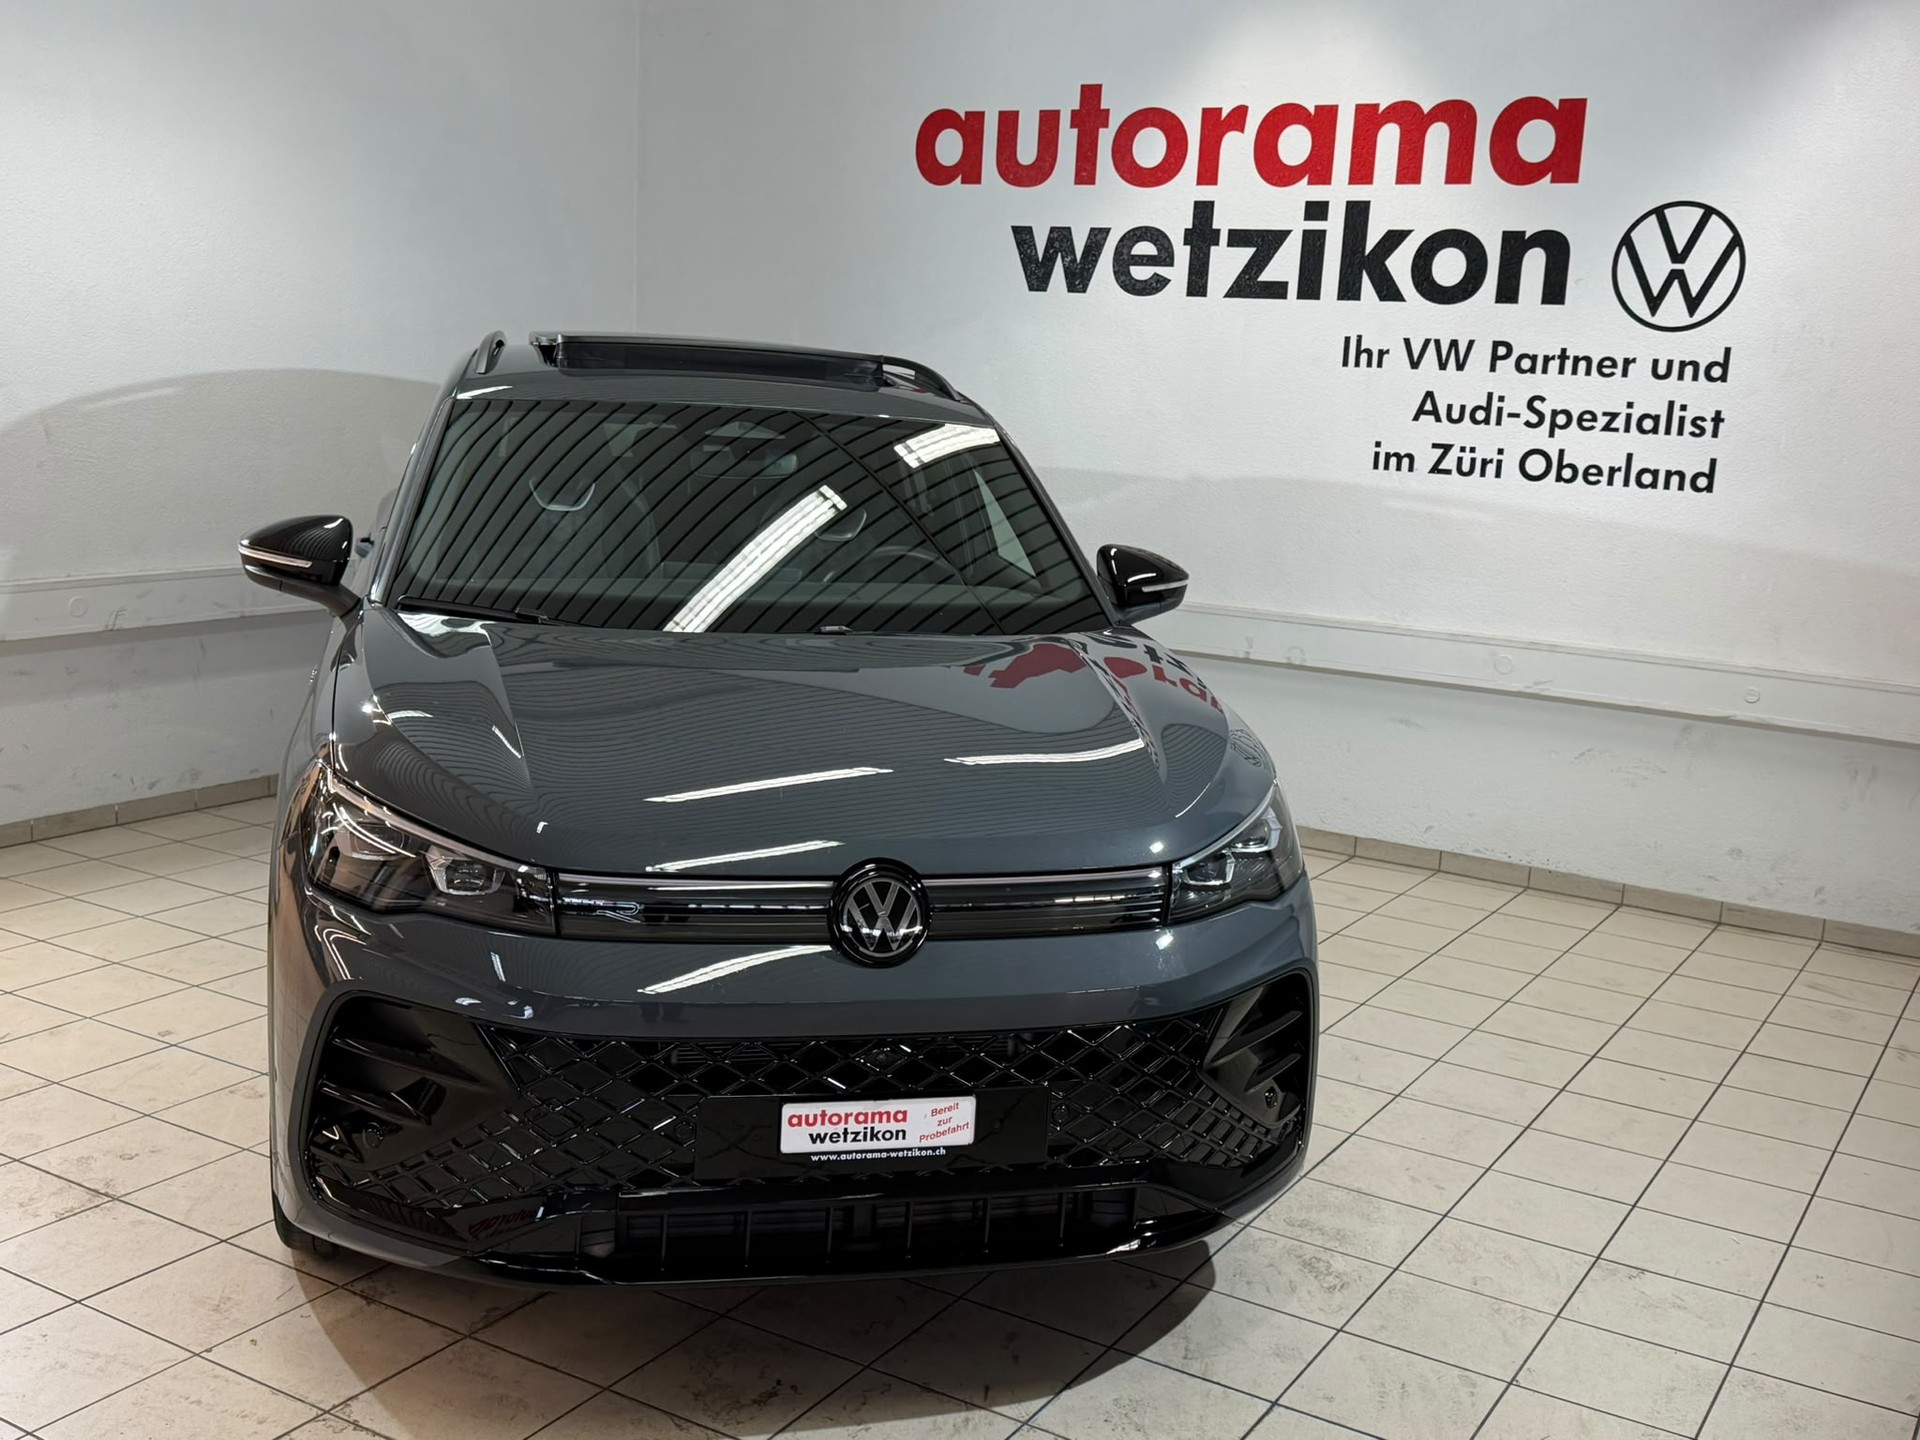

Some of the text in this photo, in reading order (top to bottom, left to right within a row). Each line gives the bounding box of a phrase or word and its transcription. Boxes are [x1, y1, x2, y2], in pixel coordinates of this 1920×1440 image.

[916, 84, 1587, 188] autorama
[1011, 200, 1570, 306] wetzikon
[1342, 334, 1732, 383] Ihr VW Partner und
[1412, 390, 1725, 439] Audi-Spezialist
[1372, 440, 1718, 494] im Züri Oberland
[787, 1109, 908, 1128] autorama
[930, 1102, 960, 1118] Bereit
[936, 1115, 953, 1127] zur
[808, 1127, 907, 1145] wetzikon
[919, 1121, 970, 1143] Probefahrt
[810, 1147, 946, 1162] www.autorama-wetzikon.ch
